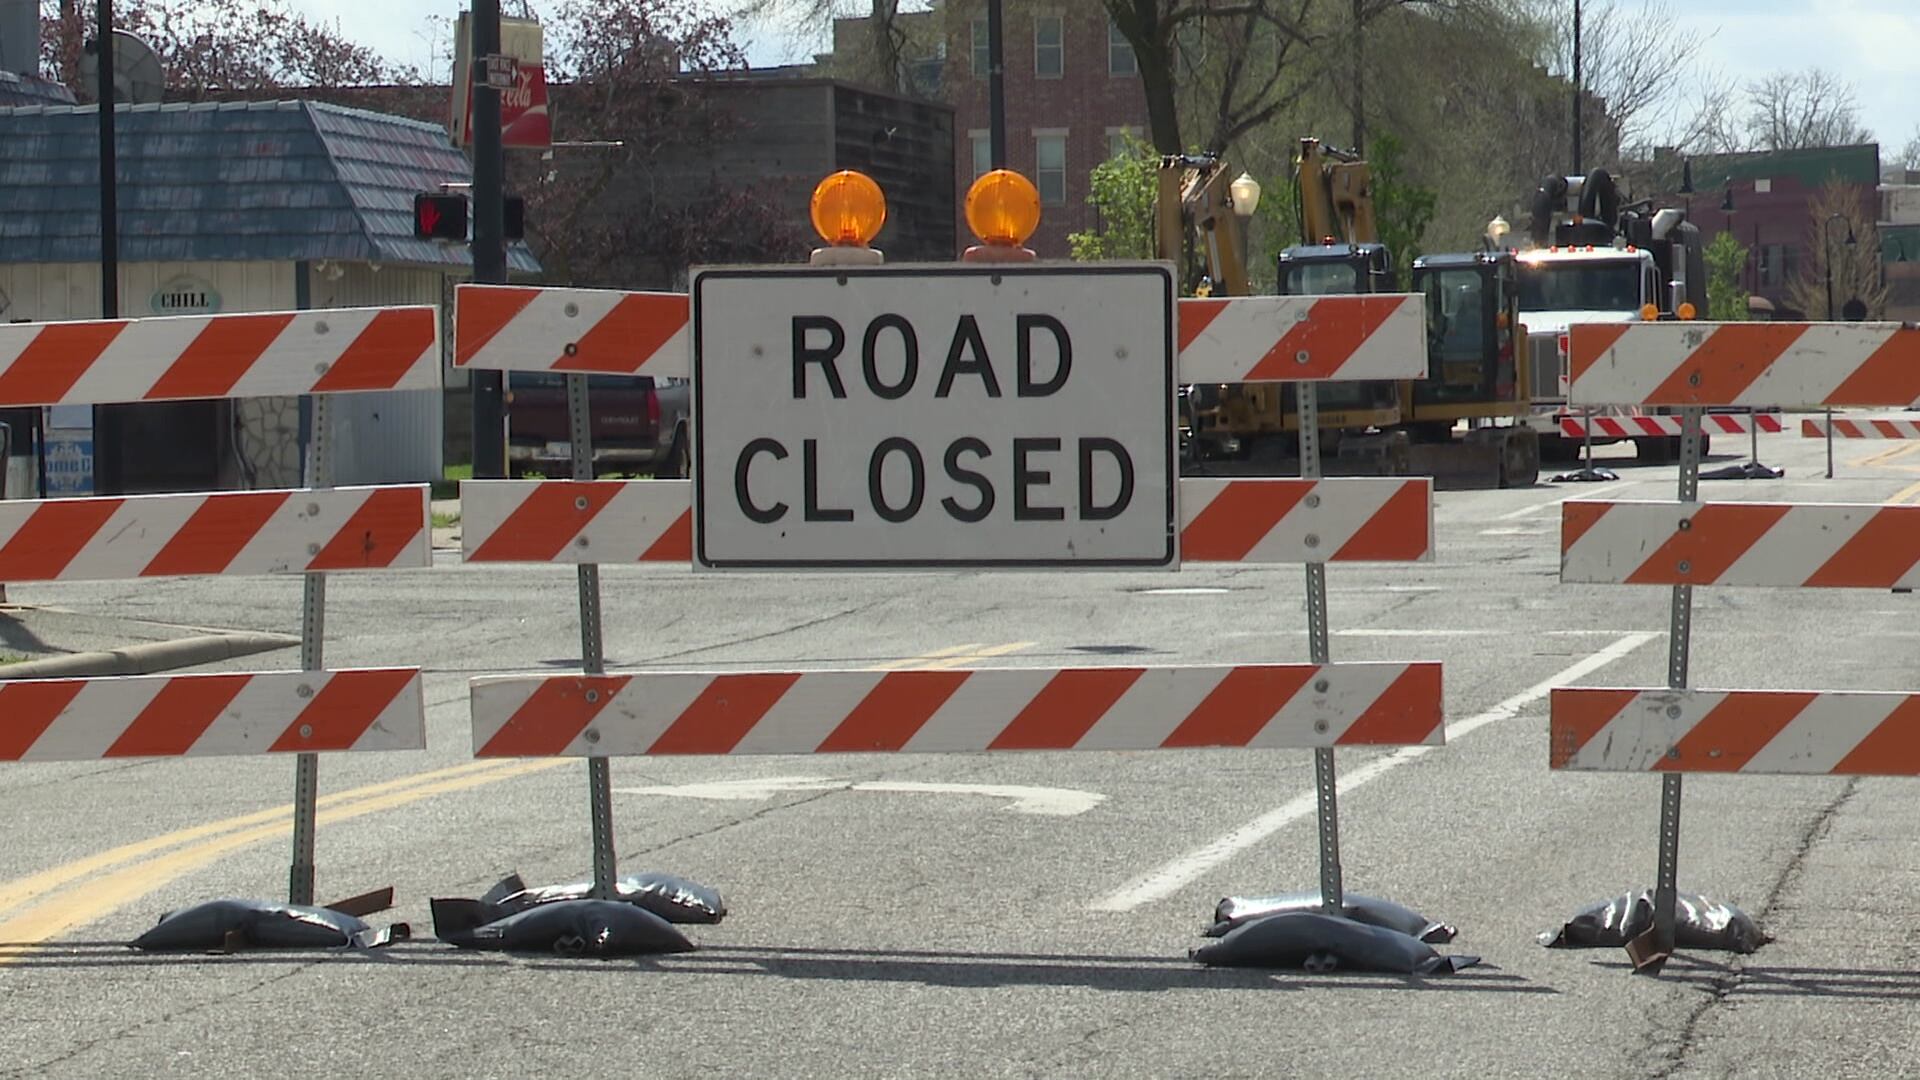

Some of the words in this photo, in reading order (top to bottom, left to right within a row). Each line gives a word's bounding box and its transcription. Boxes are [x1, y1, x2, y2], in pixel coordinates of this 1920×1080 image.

[161, 292, 209, 307] CHILL
[792, 313, 1073, 400] ROAD
[734, 436, 1135, 524] CLOSED
